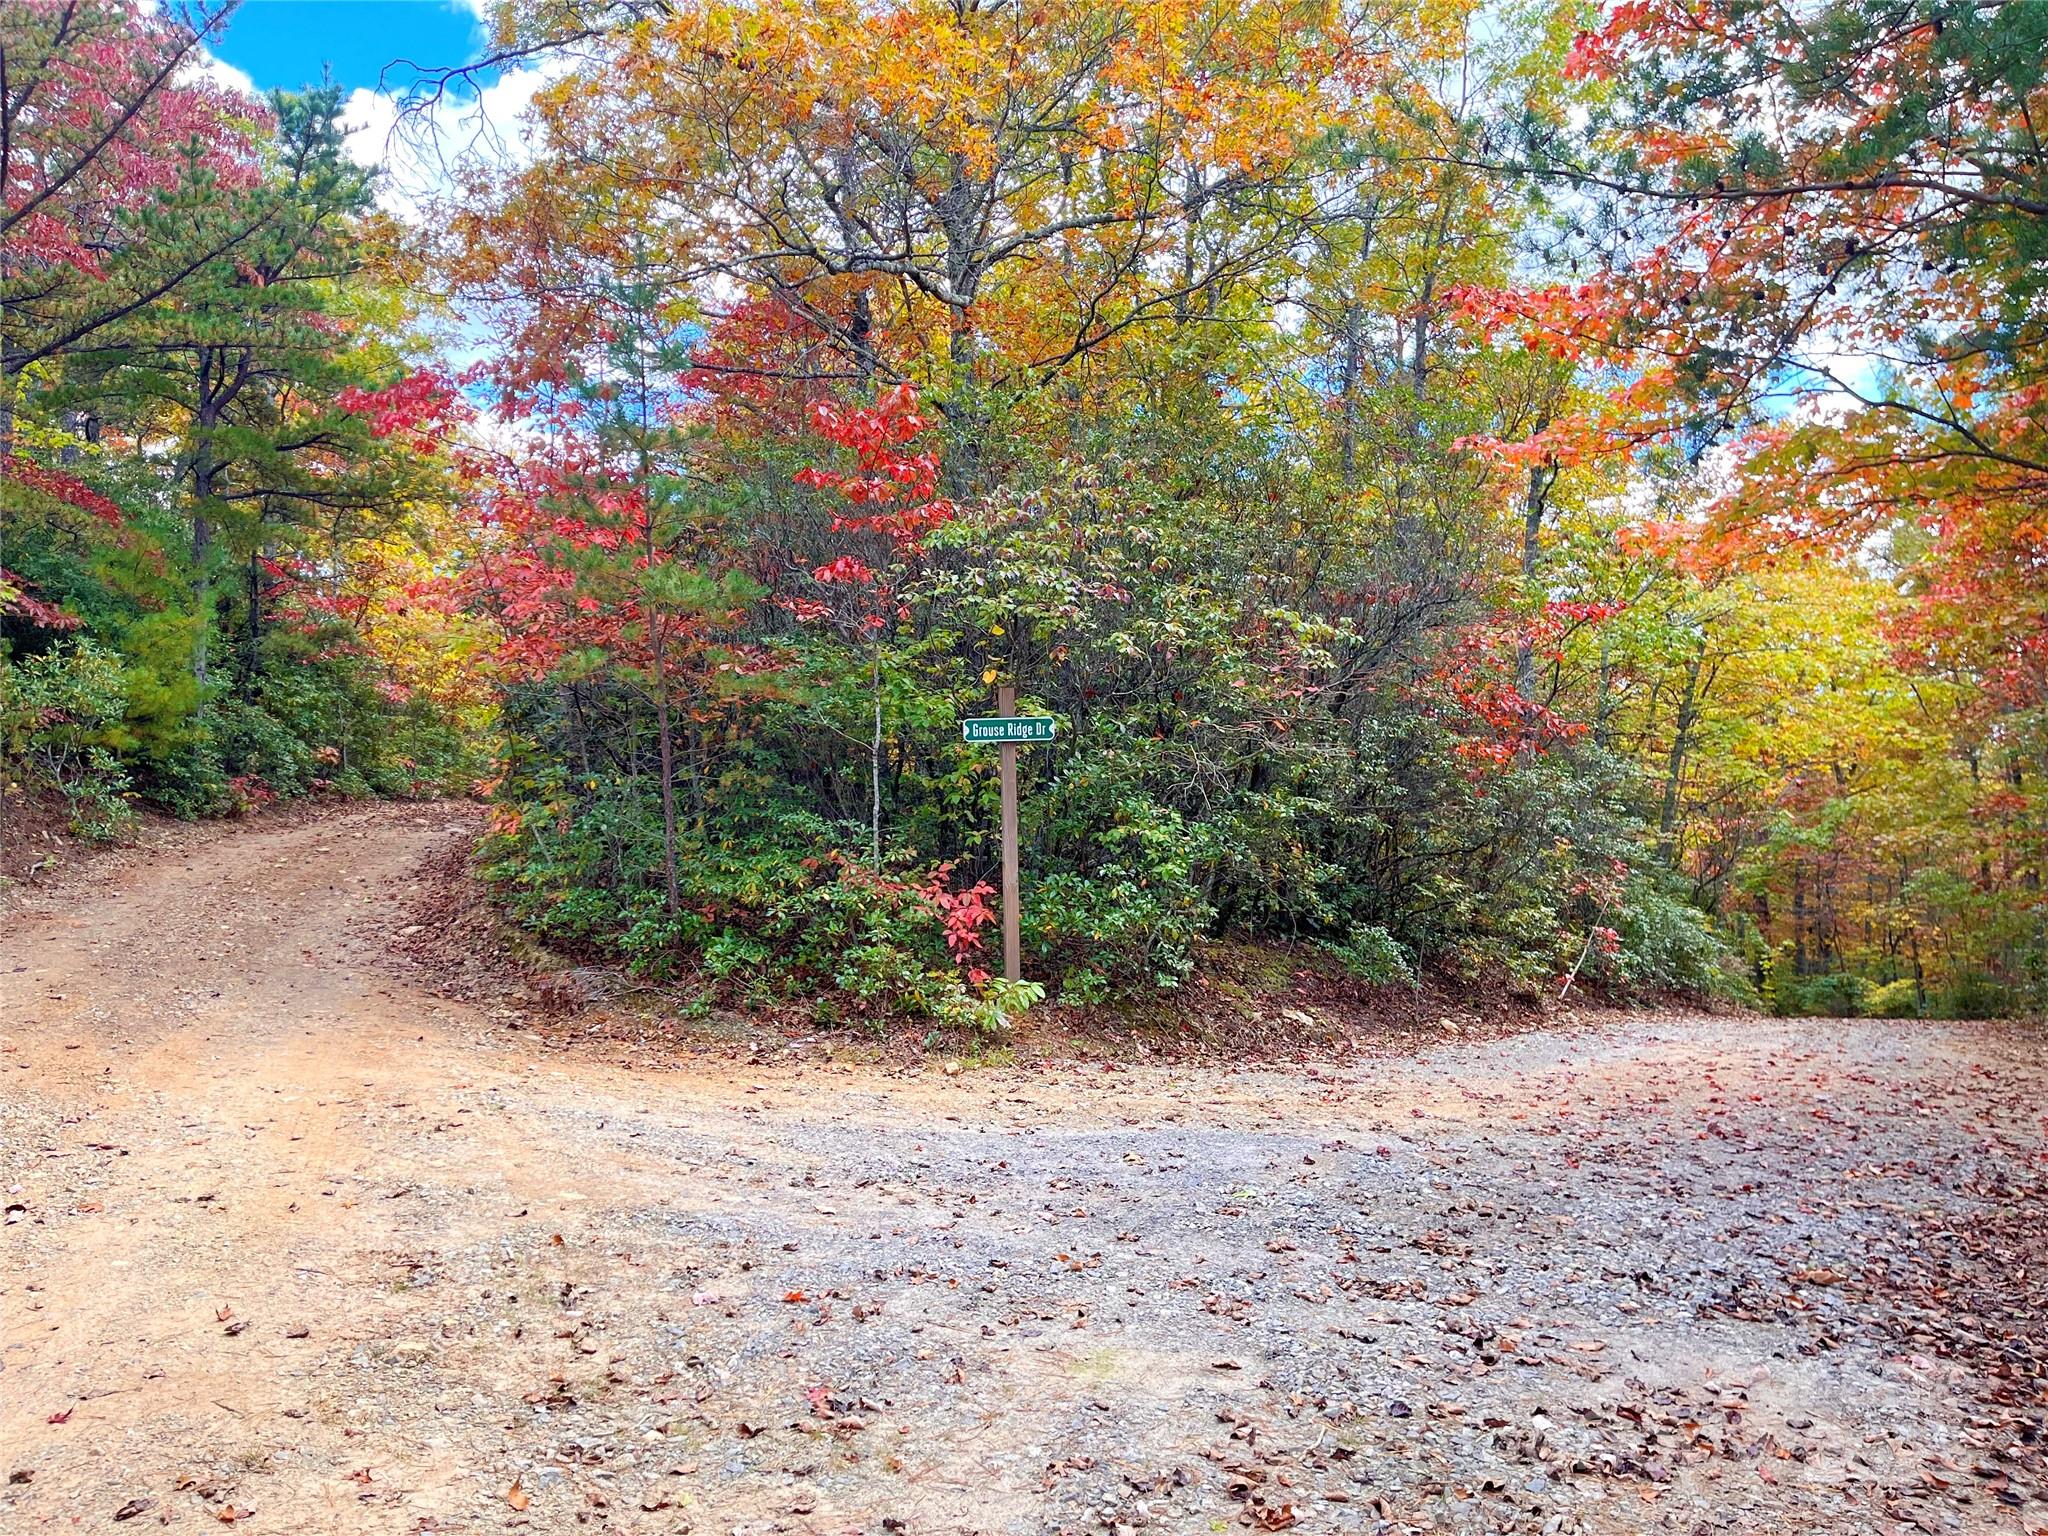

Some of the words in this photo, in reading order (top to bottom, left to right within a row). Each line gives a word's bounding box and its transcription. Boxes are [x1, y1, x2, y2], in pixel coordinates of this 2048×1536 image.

[973, 723, 1005, 737] Grouse
[1007, 722, 1033, 738] Ridge
[1036, 722, 1046, 735] Dr
